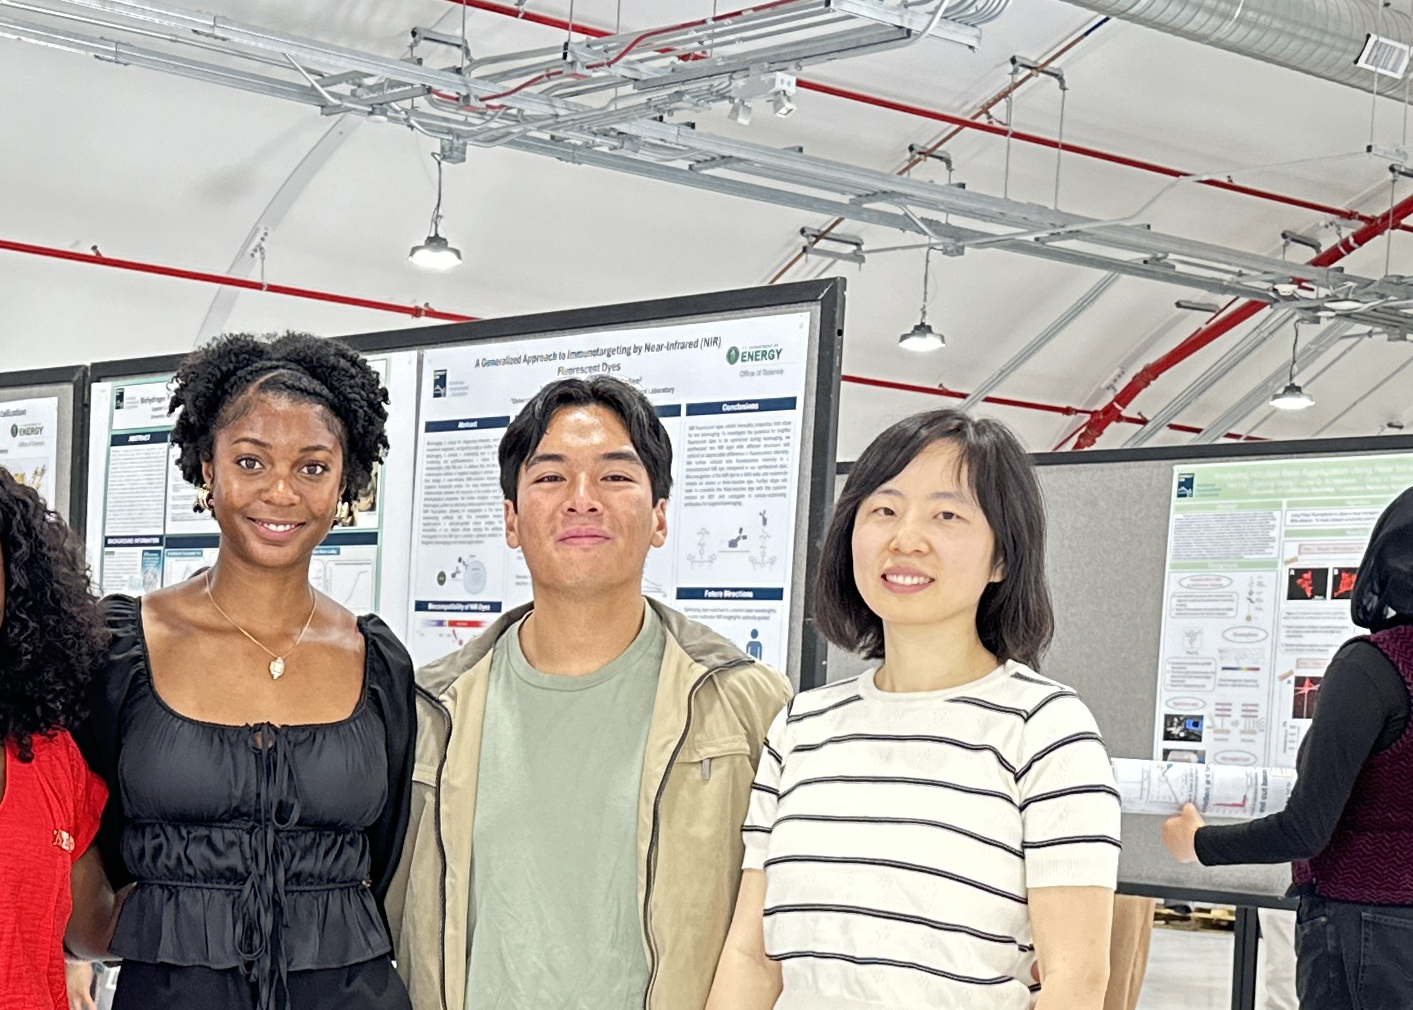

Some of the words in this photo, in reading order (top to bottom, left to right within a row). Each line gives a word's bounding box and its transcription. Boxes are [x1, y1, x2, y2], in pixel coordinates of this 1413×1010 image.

[475, 358, 480, 368] A
[481, 355, 522, 368] Generalized
[522, 352, 557, 365] Approach
[558, 352, 566, 360] to
[567, 345, 632, 360] Immunotargeting
[633, 344, 642, 355] by
[644, 338, 698, 352] Near-Infrared
[700, 336, 722, 349] (NIR)
[740, 348, 783, 362] ENERGY
[557, 363, 600, 376] Fluorescent
[602, 362, 621, 374] Dyes
[740, 369, 755, 378] Office
[722, 402, 759, 411] Conclusions
[704, 590, 723, 598] Future
